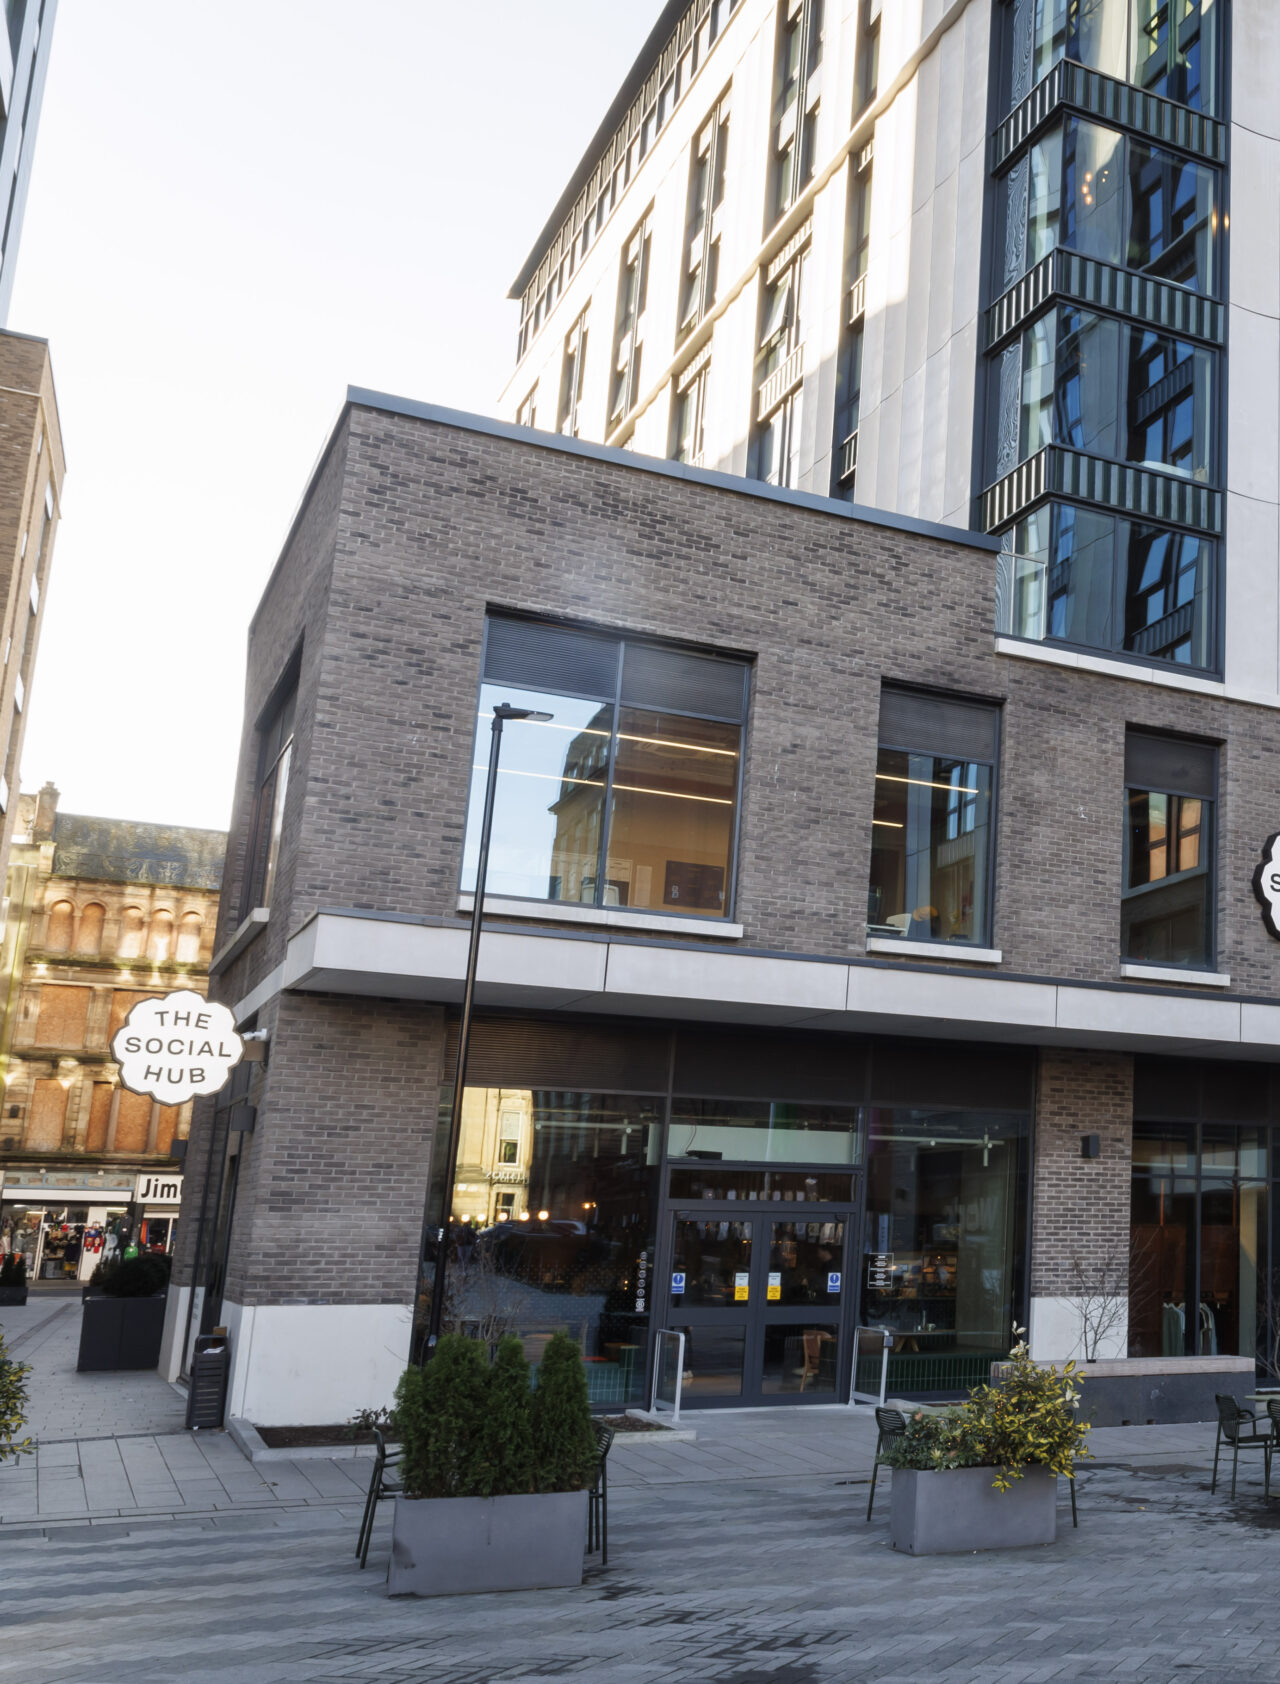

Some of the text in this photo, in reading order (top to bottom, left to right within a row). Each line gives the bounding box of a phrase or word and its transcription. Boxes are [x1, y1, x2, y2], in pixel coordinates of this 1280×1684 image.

[154, 1010, 213, 1030] THE
[124, 1036, 232, 1058] SOCIAL
[143, 1064, 206, 1085] HUB
[141, 1177, 183, 1199] Jim
